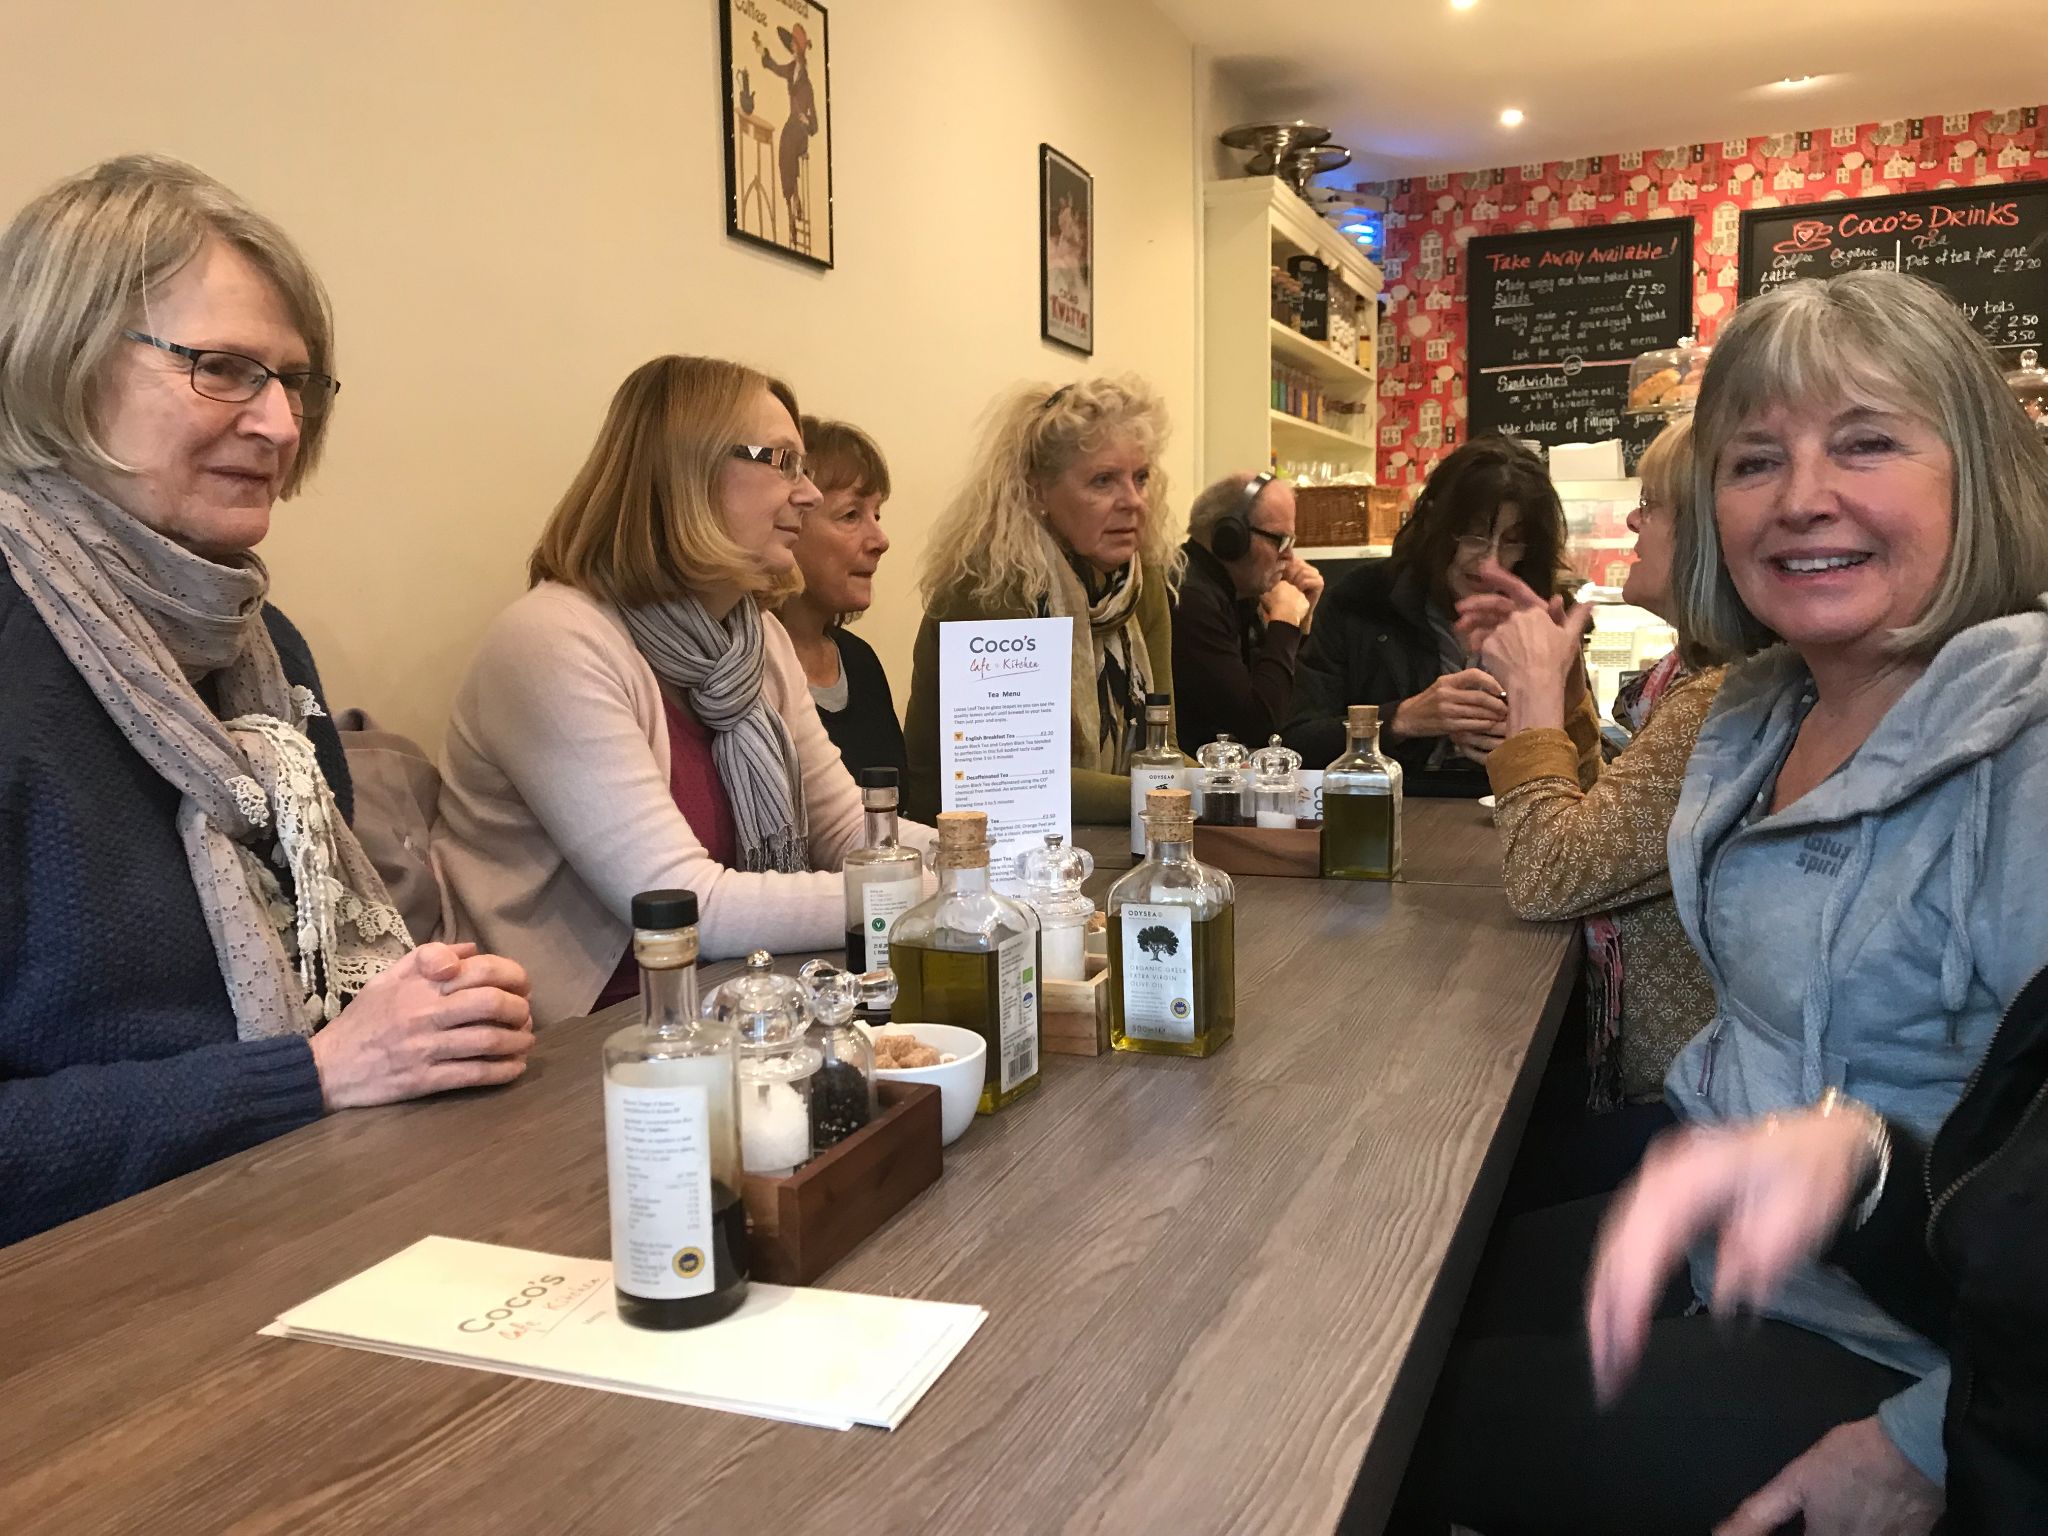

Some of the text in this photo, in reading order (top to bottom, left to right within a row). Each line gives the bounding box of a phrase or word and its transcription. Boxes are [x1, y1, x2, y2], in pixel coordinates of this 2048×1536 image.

[1839, 211, 1923, 238] Coco's
[1485, 252, 1531, 272] Take
[1539, 249, 1584, 271] Away
[1935, 249, 1948, 265] of
[1950, 249, 1971, 263] tea
[1761, 268, 1797, 282] Latte
[1630, 336, 1658, 346] menu
[1497, 372, 1569, 392] Sandwiches
[1525, 420, 1557, 433] choice
[1565, 417, 1578, 433] of
[969, 635, 1036, 654] Coco's
[458, 1274, 566, 1333] Coco's
